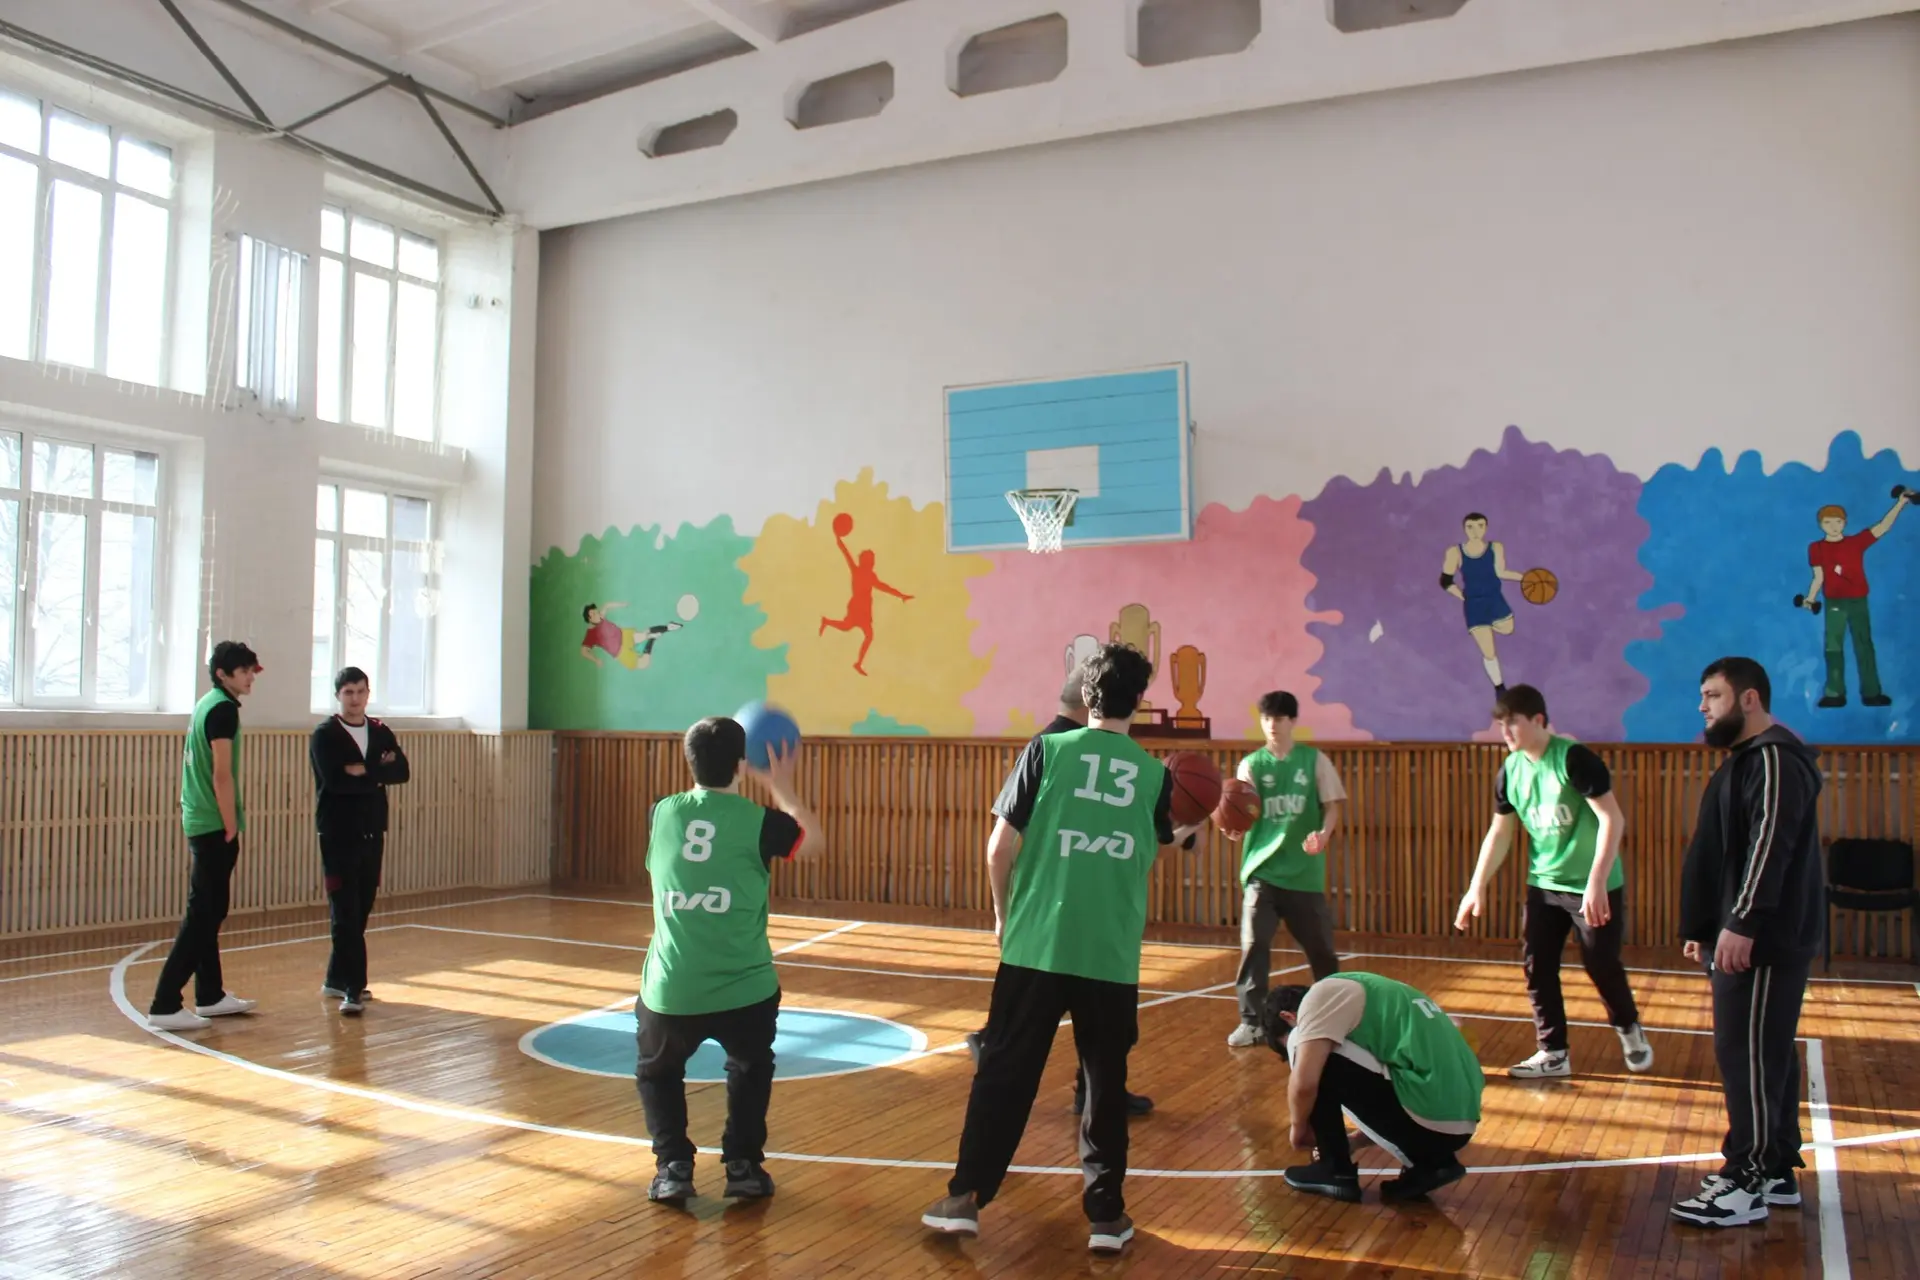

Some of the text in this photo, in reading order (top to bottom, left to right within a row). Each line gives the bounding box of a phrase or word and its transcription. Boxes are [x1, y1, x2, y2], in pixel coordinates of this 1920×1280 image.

[1074, 754, 1138, 807] 13
[1293, 768, 1308, 786] 4
[682, 820, 716, 862] 8
